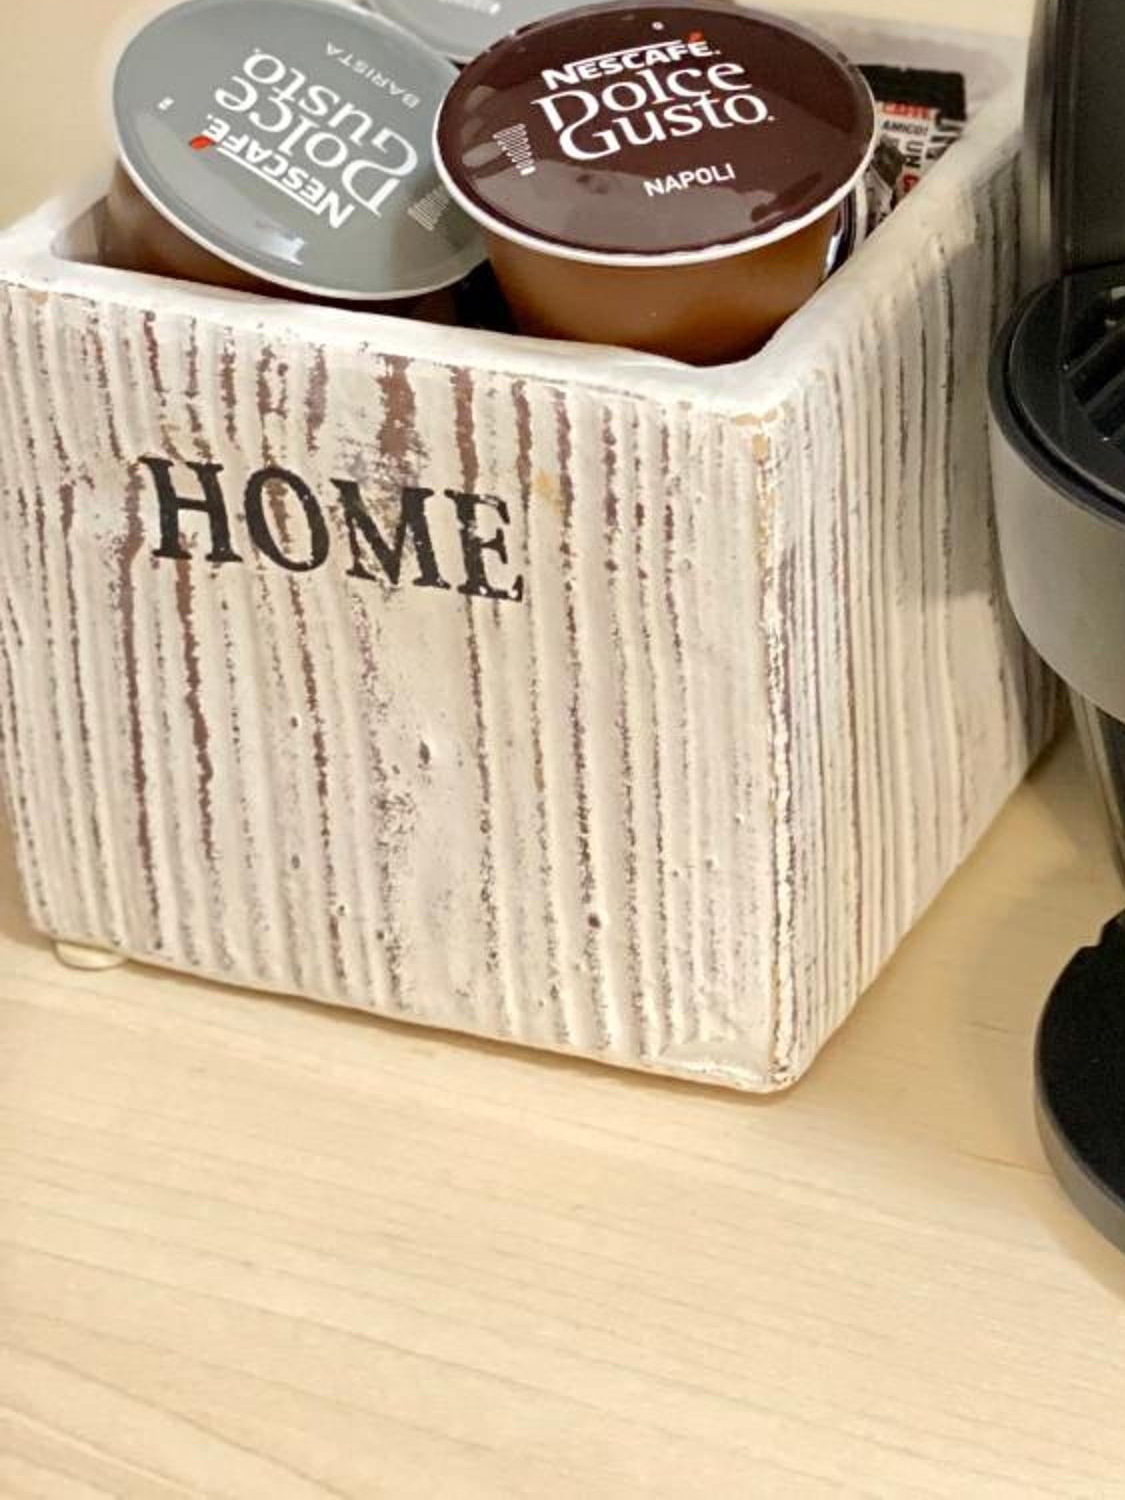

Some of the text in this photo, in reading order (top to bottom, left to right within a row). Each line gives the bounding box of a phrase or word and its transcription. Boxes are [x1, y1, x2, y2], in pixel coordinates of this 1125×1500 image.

[325, 42, 421, 109] BARISTA
[530, 60, 753, 133] Dolce
[214, 76, 400, 218] Dolce
[643, 163, 736, 197] NAPOLI
[138, 455, 524, 602] HOME
